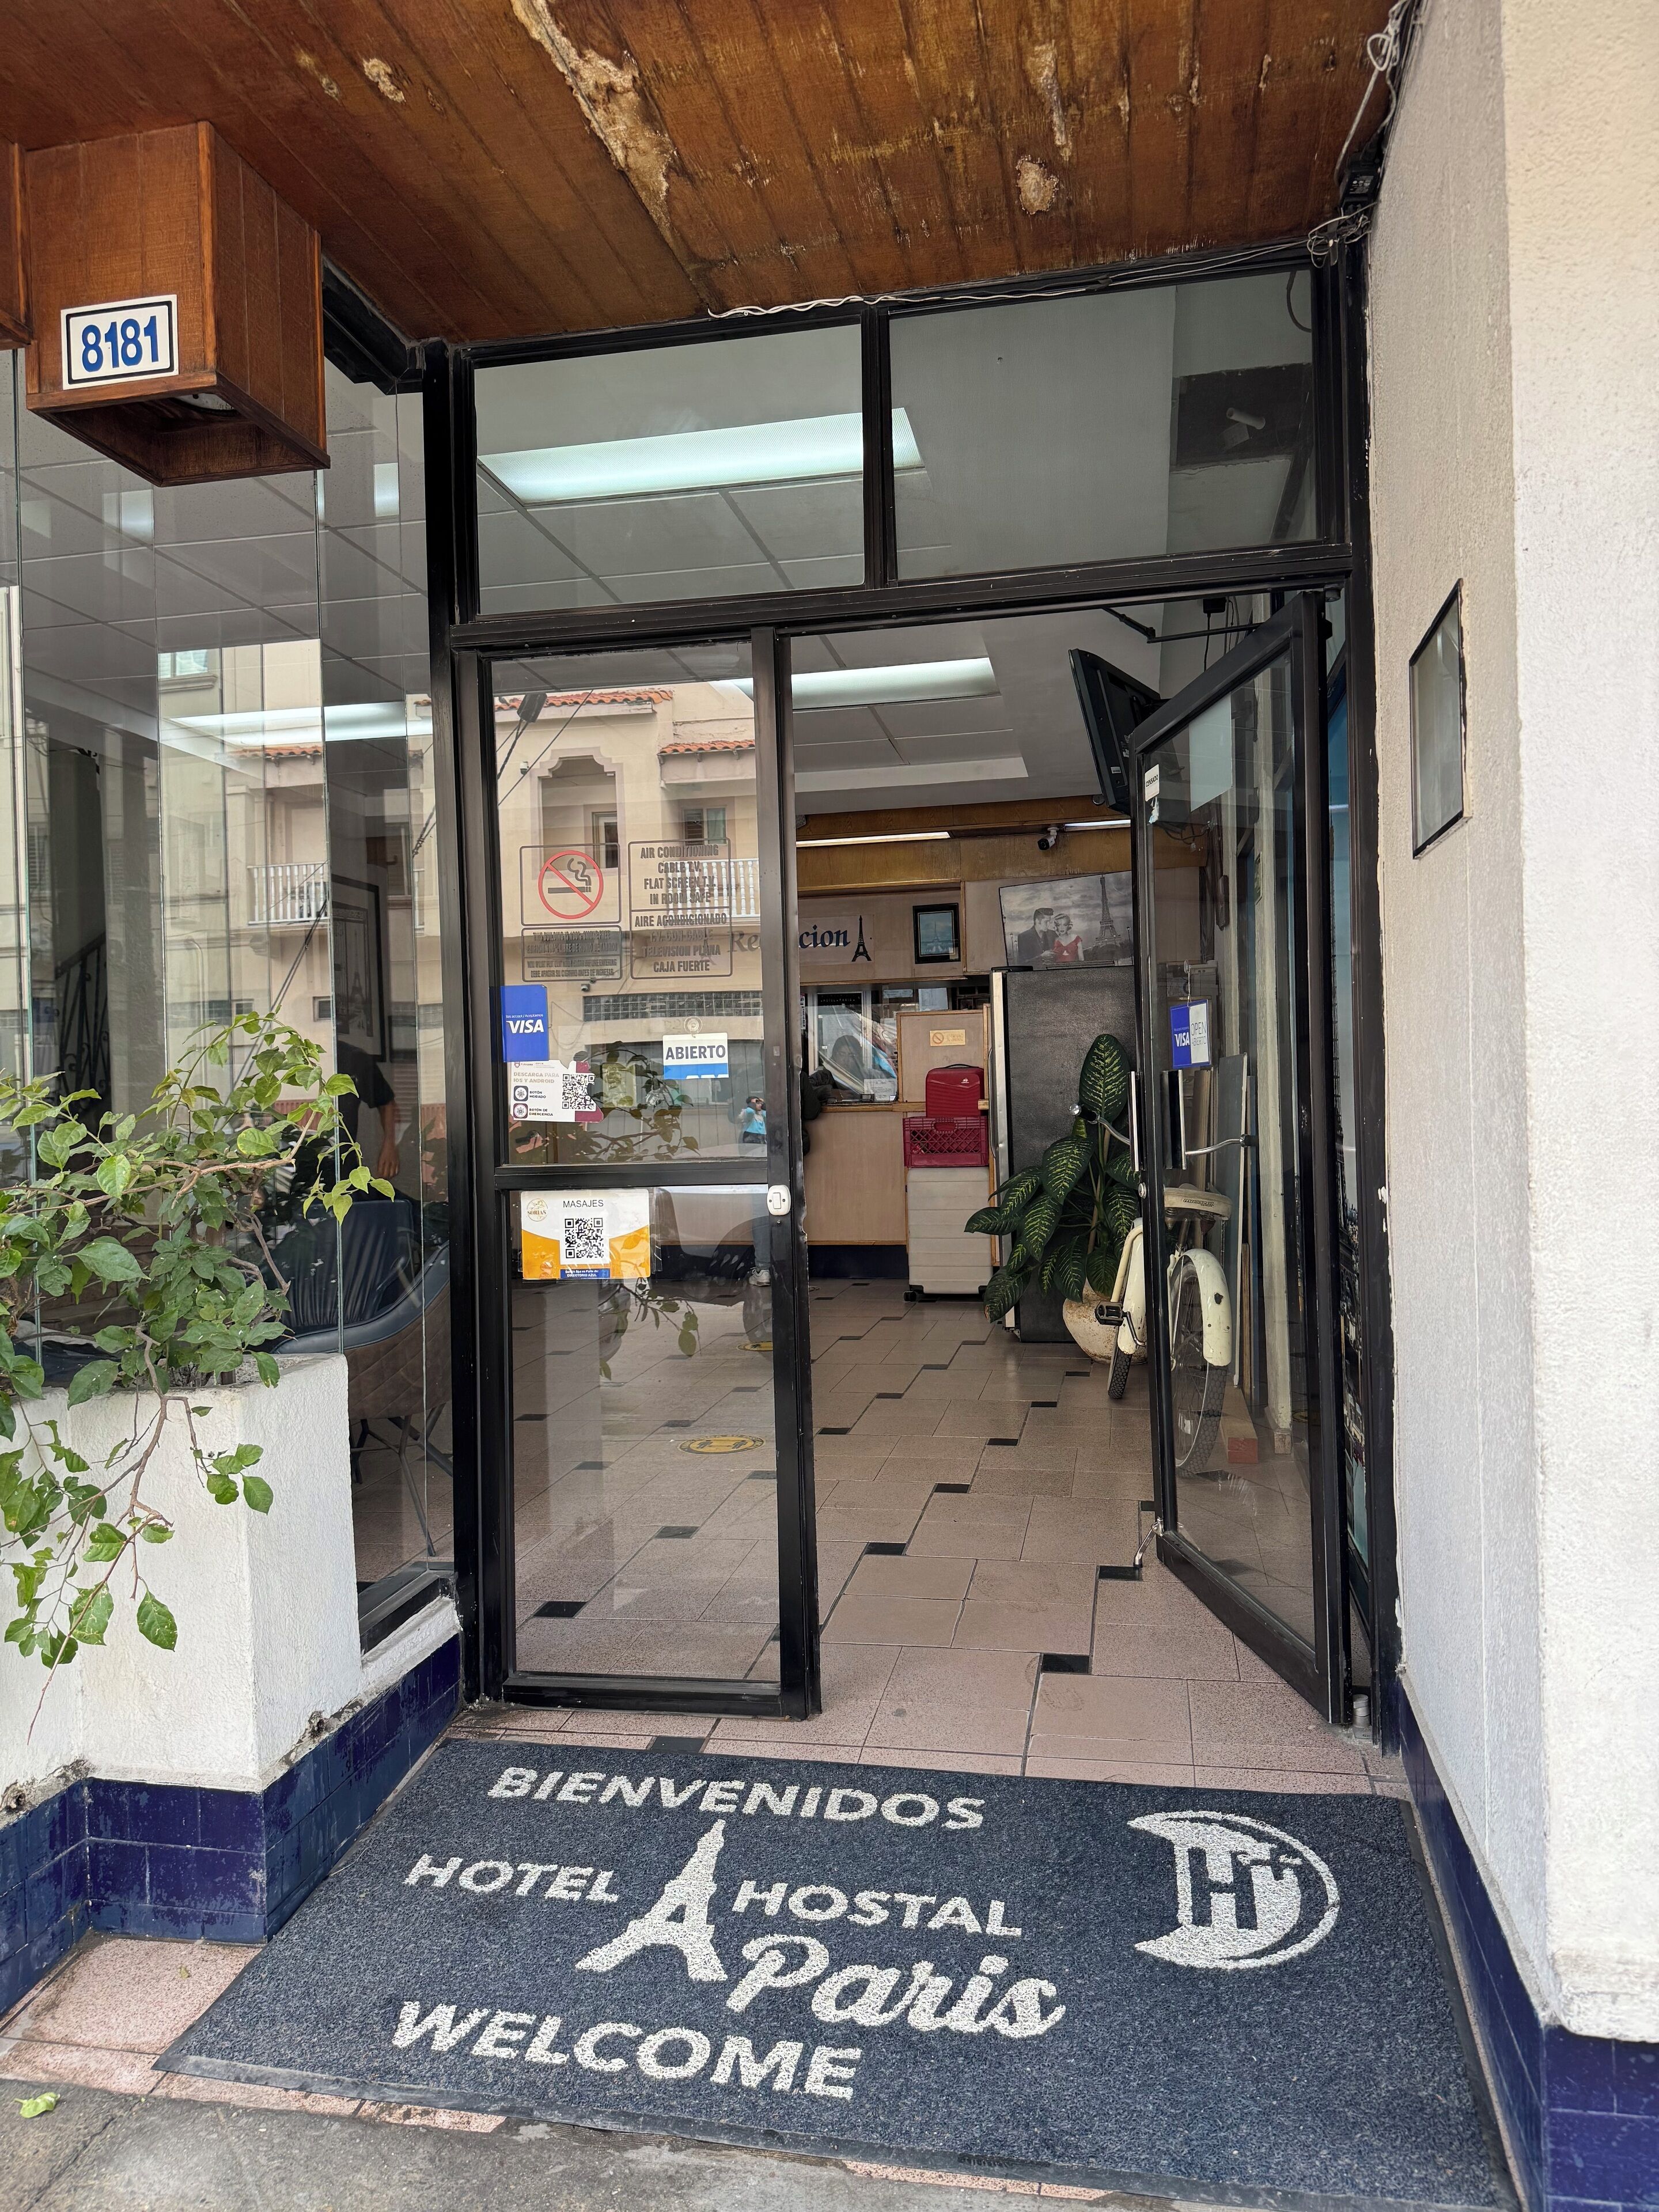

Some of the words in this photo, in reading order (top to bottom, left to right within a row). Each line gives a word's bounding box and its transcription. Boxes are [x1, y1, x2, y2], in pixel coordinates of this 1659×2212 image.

[82, 315, 159, 372] 8181
[641, 847, 655, 858] AIR
[657, 844, 719, 858] CONDITIONING
[658, 861, 685, 873] CABLE
[644, 878, 664, 889] FLAT
[666, 876, 700, 888] SCREEN
[650, 893, 659, 904] IN
[662, 892, 687, 904] ROOM
[689, 892, 711, 903] SAFE
[635, 915, 654, 927] AIRE
[657, 912, 727, 926] ACONDICIONADO
[666, 930, 684, 942] CON
[687, 929, 713, 941] CABLE
[641, 946, 691, 957] TELEVISION
[693, 945, 721, 956] PLANA
[653, 961, 676, 972] CAJA
[677, 960, 710, 972] FUERTE
[506, 1019, 544, 1034] VISA
[1191, 1022, 1206, 1036] OPEN
[1174, 1032, 1190, 1047] VISA
[665, 1044, 726, 1060] ABIERTO
[563, 1199, 604, 1208] MASAJES
[488, 1767, 984, 1829] BIENVENIDOS
[403, 1853, 619, 1903] HOTEL
[732, 1880, 1022, 1937] HOSTAL
[726, 1933, 1066, 2039] Paris
[392, 2000, 861, 2101] WELCOME
